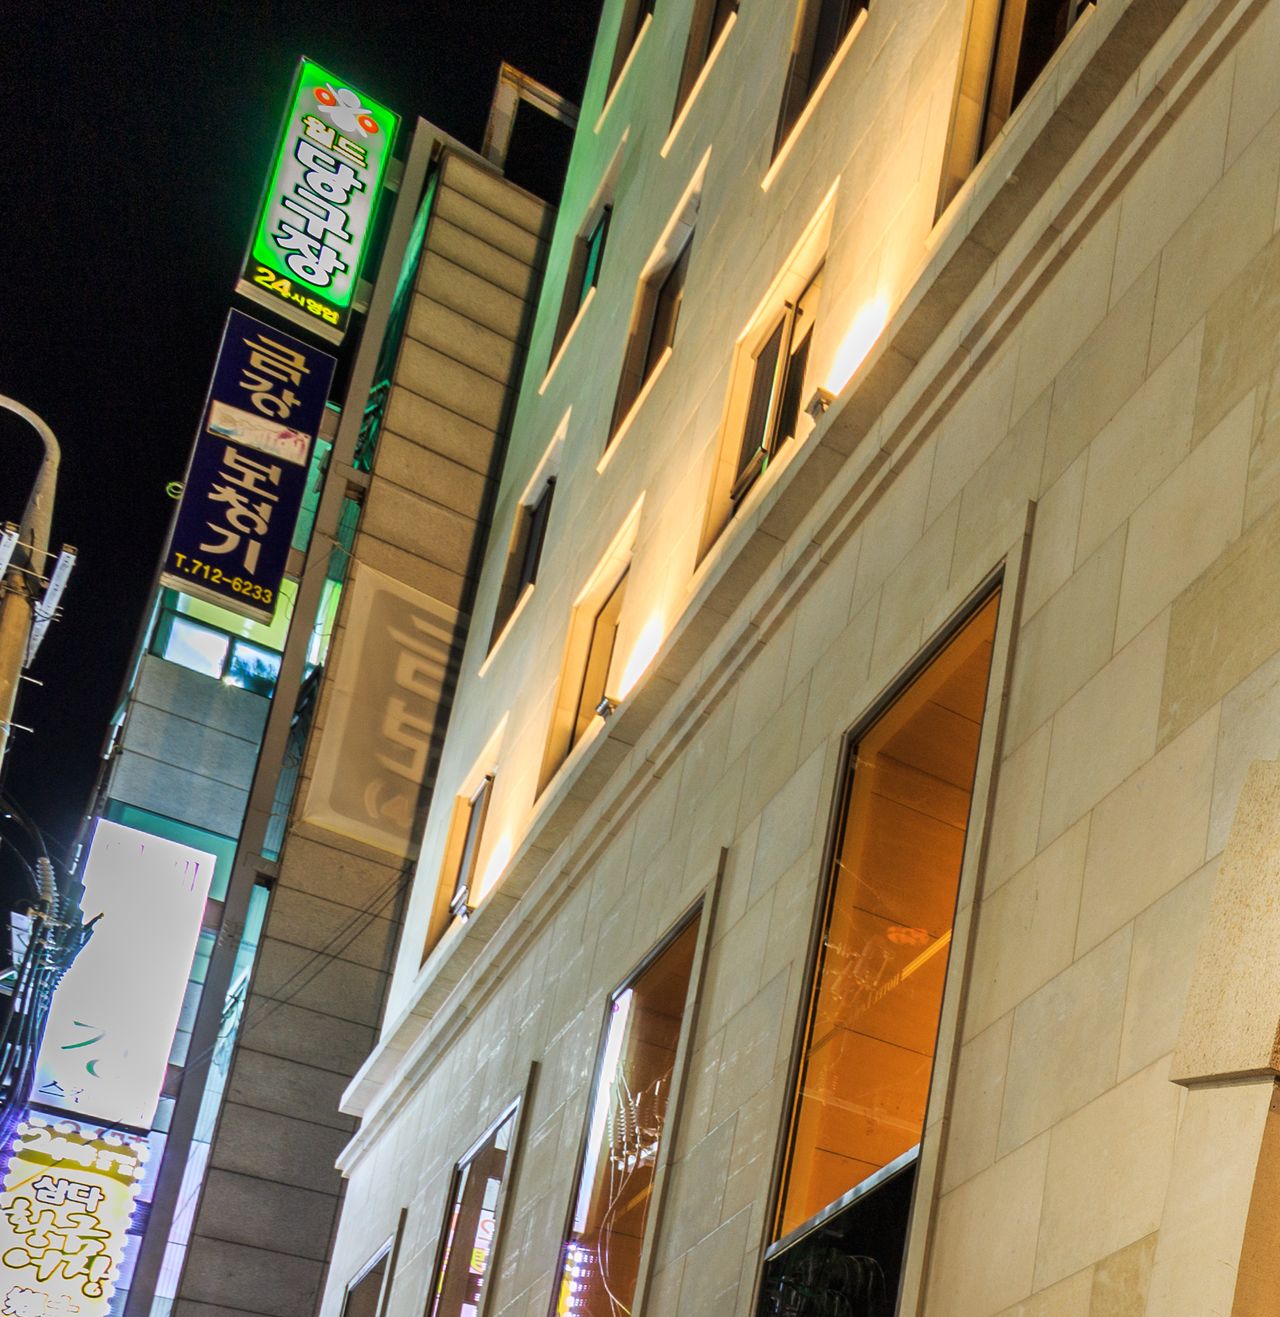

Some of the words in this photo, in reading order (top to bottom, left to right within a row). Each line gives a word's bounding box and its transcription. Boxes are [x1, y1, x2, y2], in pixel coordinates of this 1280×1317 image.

[272, 138, 366, 287] 당구장
[239, 334, 310, 417] 금강
[200, 446, 283, 576] 보청기
[32, 1175, 106, 1213] 삼다
